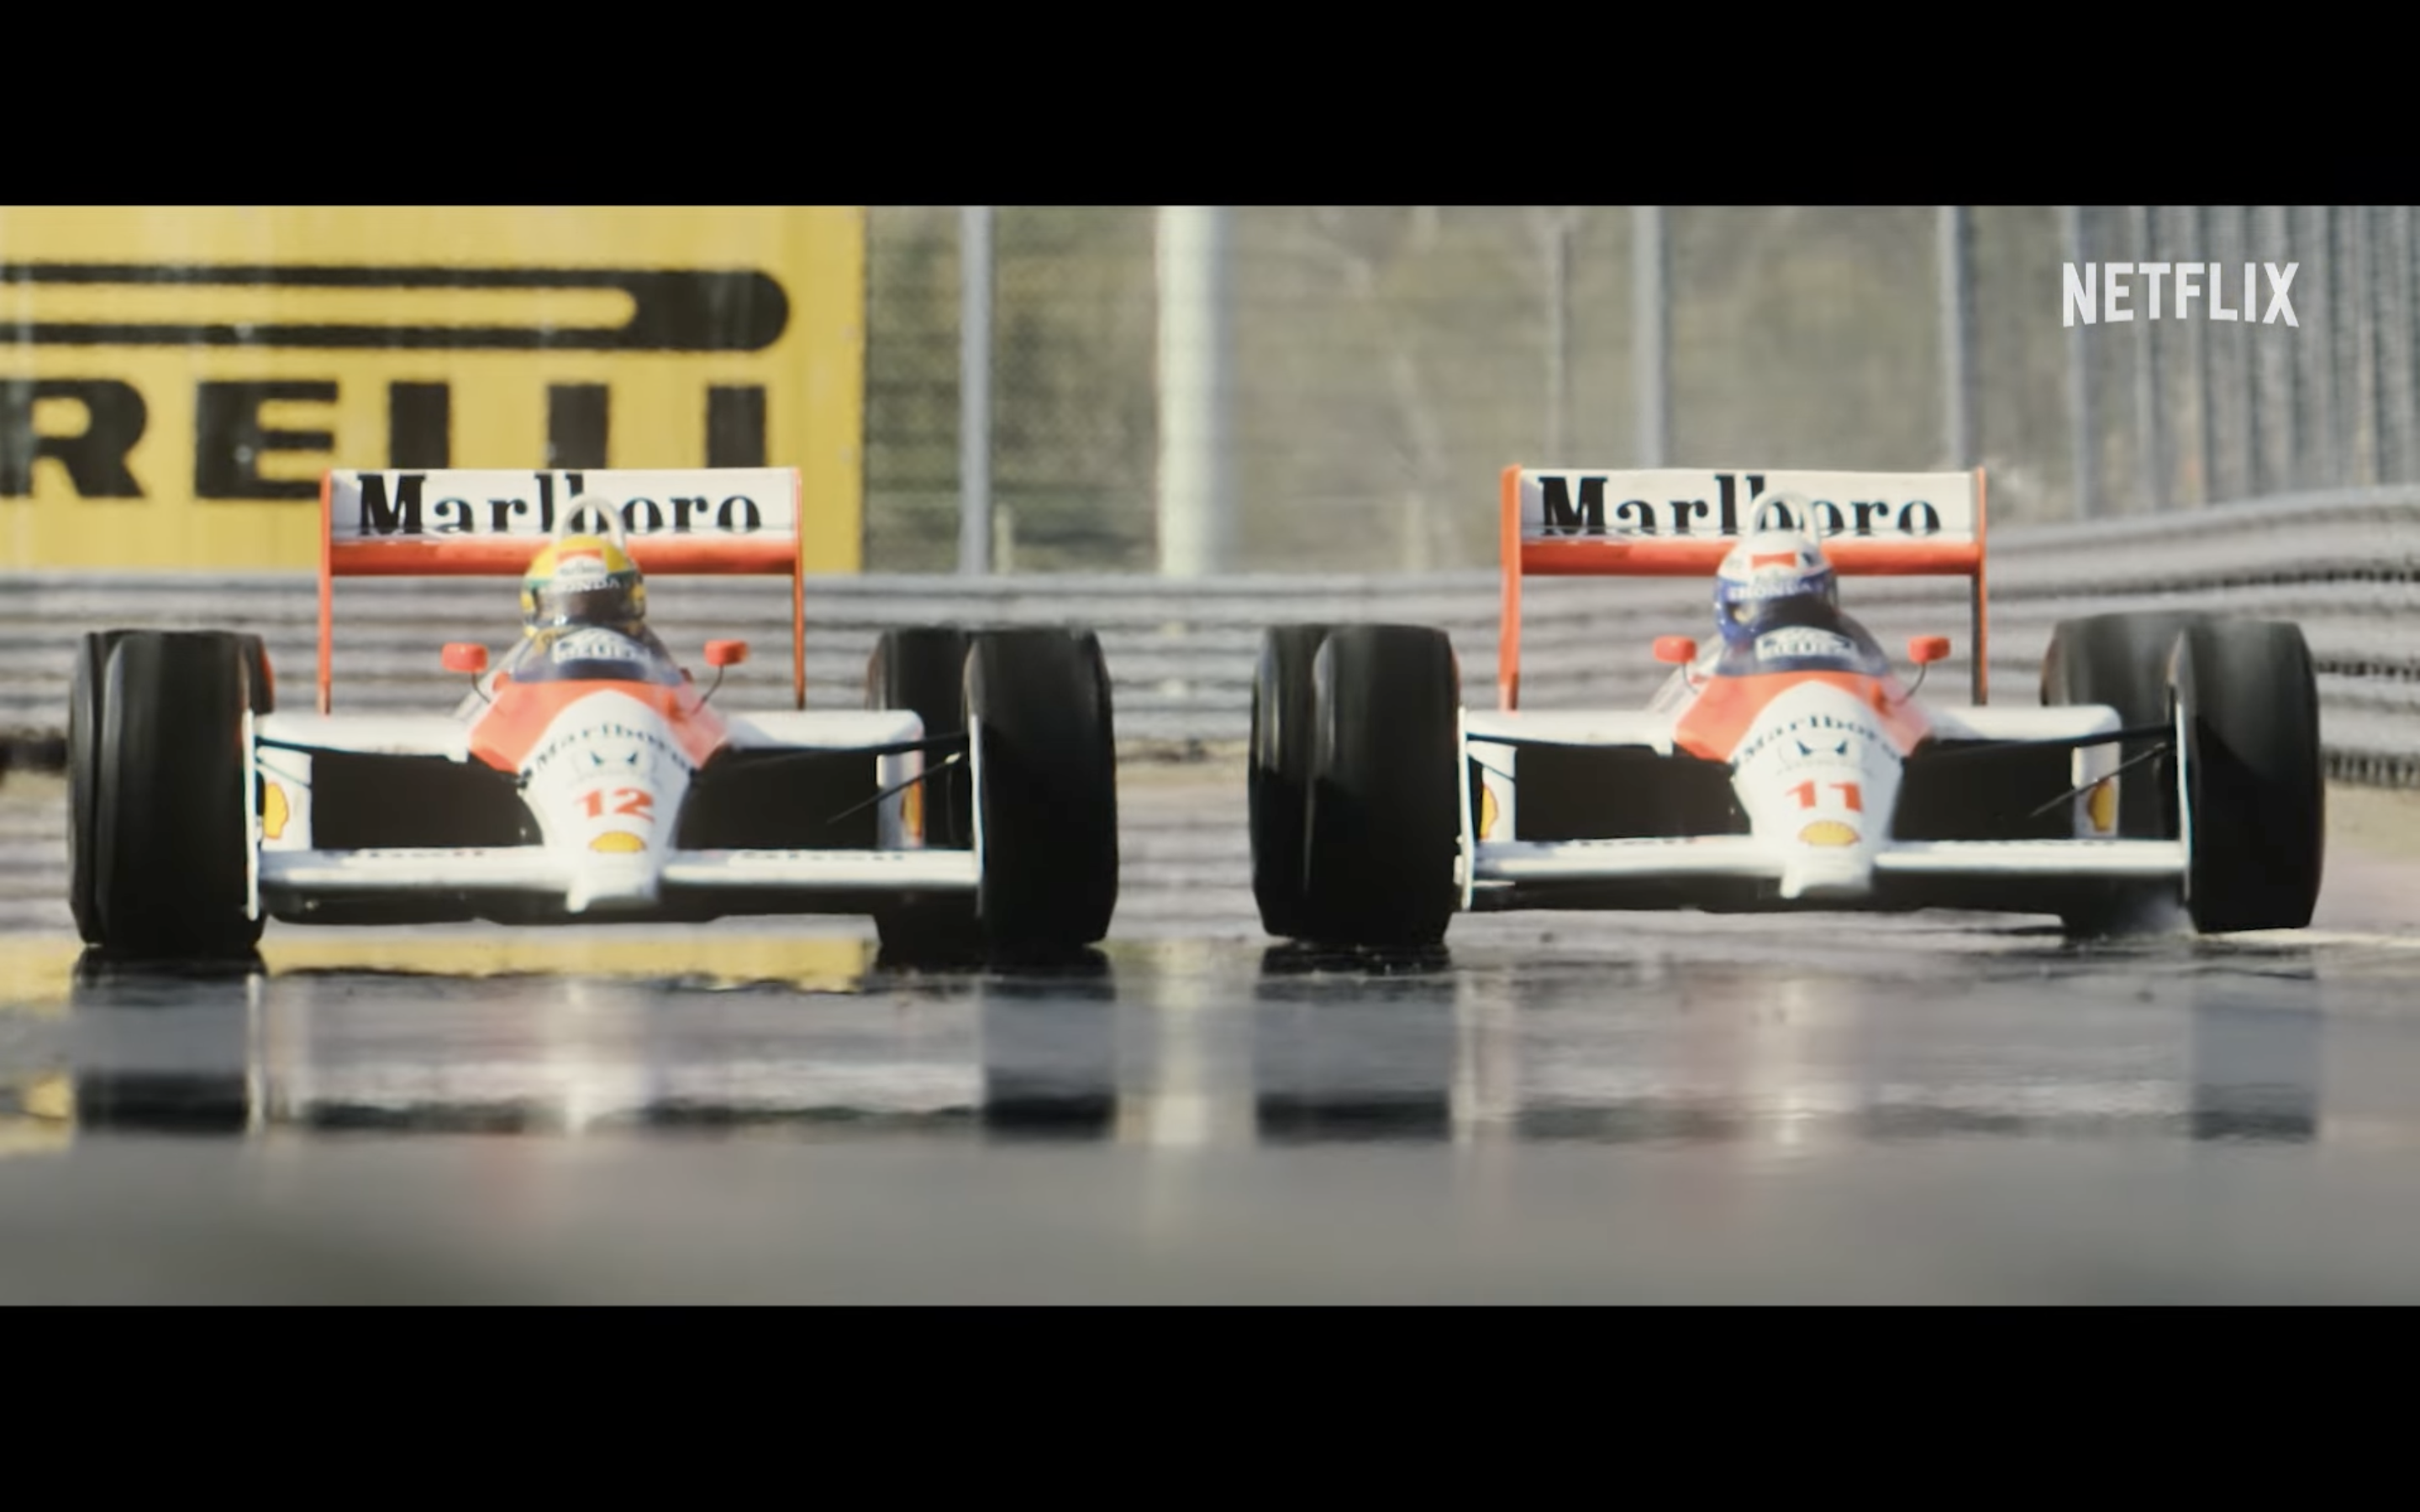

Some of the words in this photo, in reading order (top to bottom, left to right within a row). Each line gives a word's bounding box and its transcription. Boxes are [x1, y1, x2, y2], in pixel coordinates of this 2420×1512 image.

[356, 472, 762, 535] Marlboro
[578, 788, 655, 823] 12
[1786, 780, 1862, 811] 11
